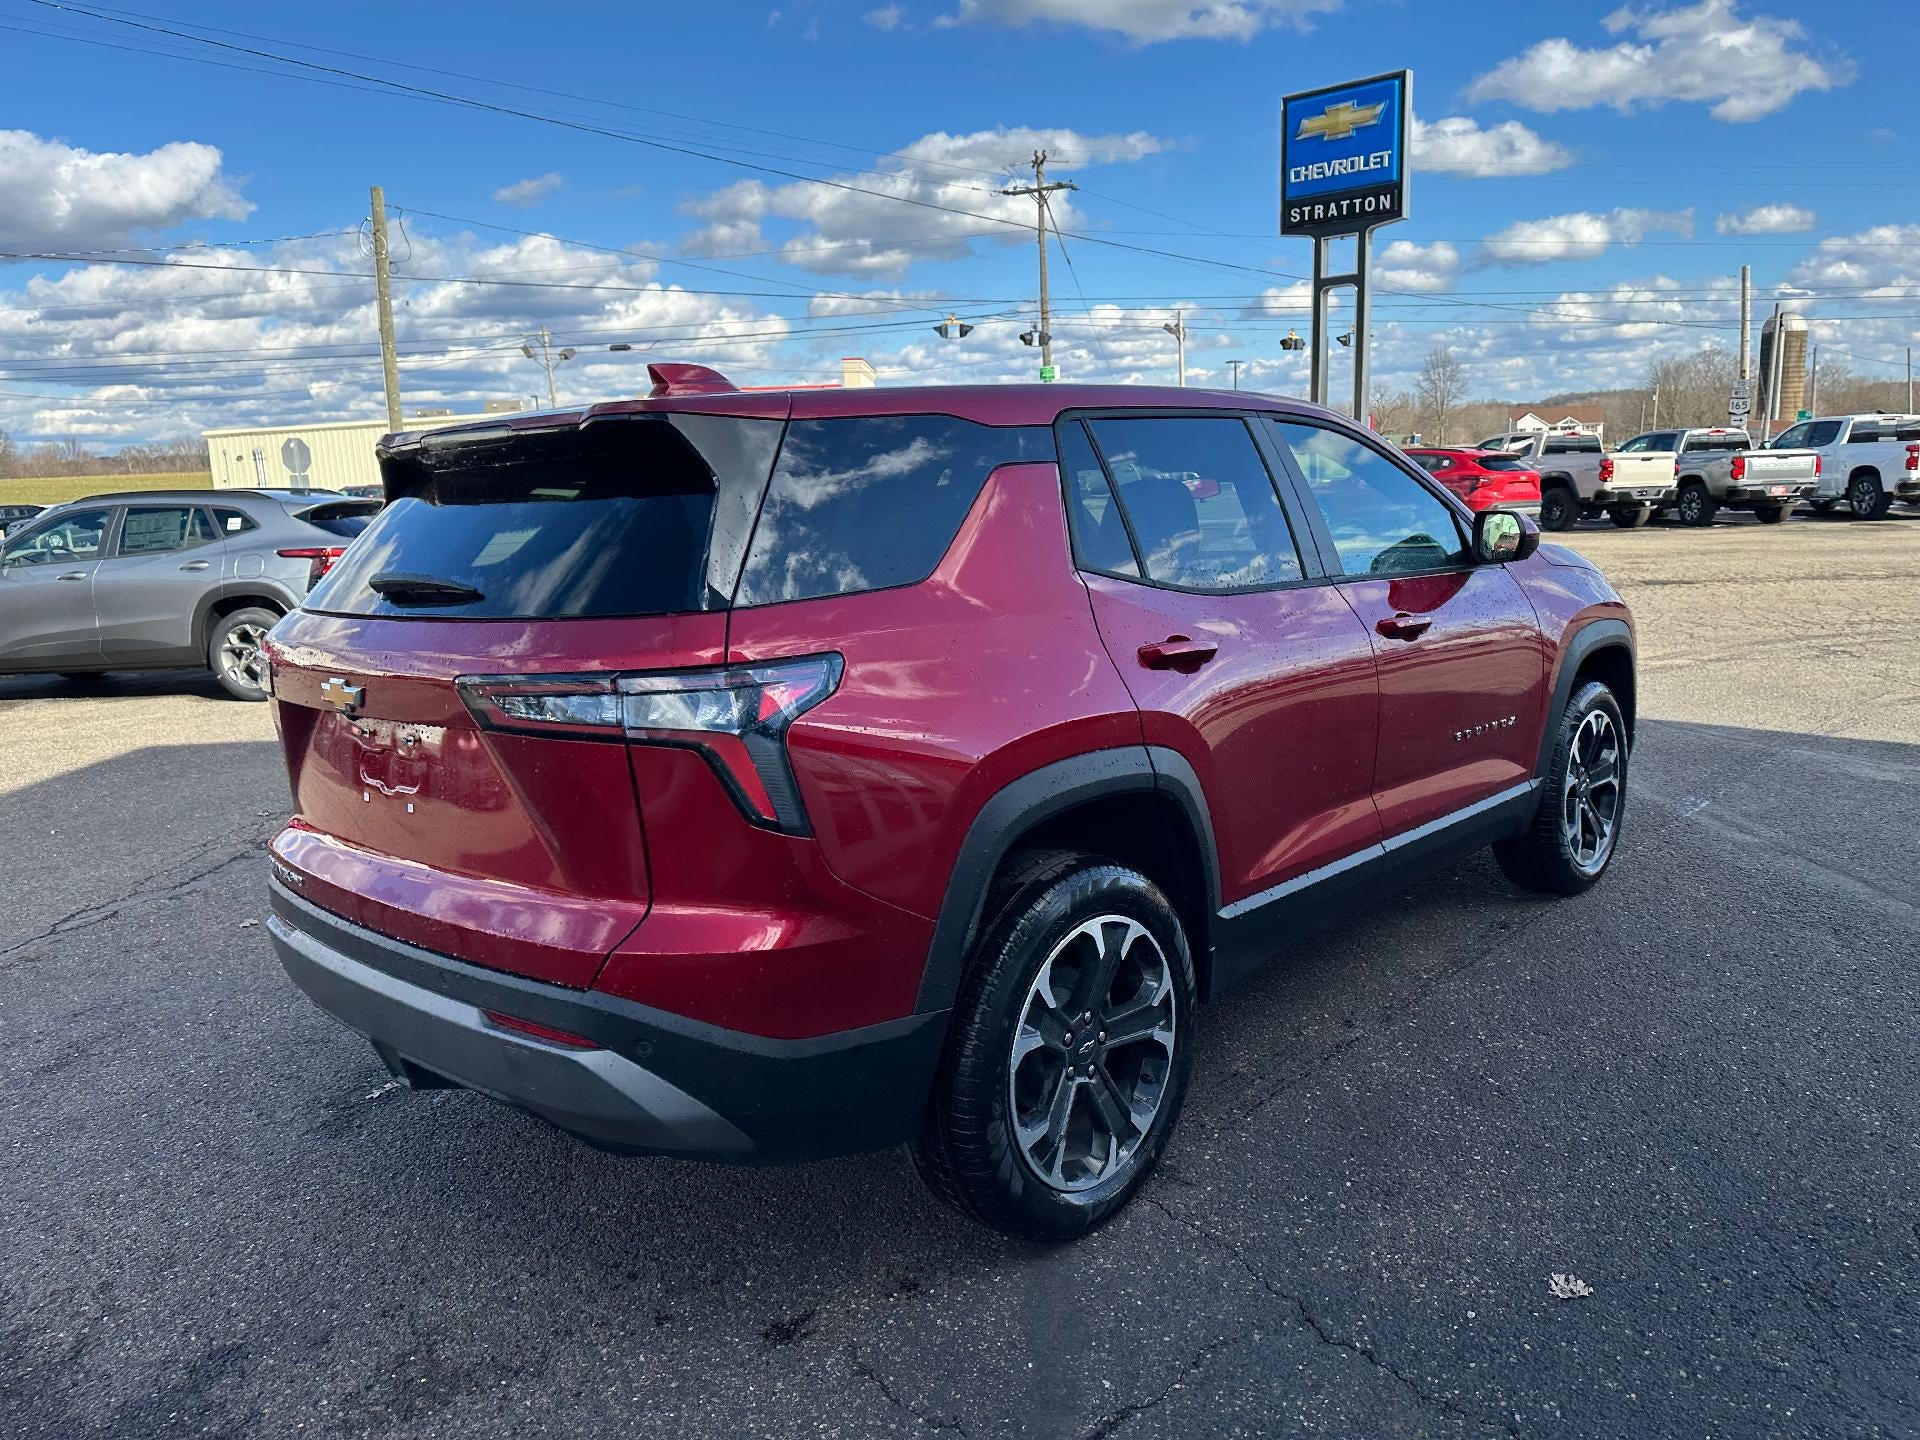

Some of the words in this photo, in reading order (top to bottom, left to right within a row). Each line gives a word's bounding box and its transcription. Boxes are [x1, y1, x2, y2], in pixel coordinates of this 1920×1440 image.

[1289, 150, 1392, 184] CHEVROLET
[1290, 194, 1391, 223] STRATTON
[1731, 400, 1748, 410] 165
